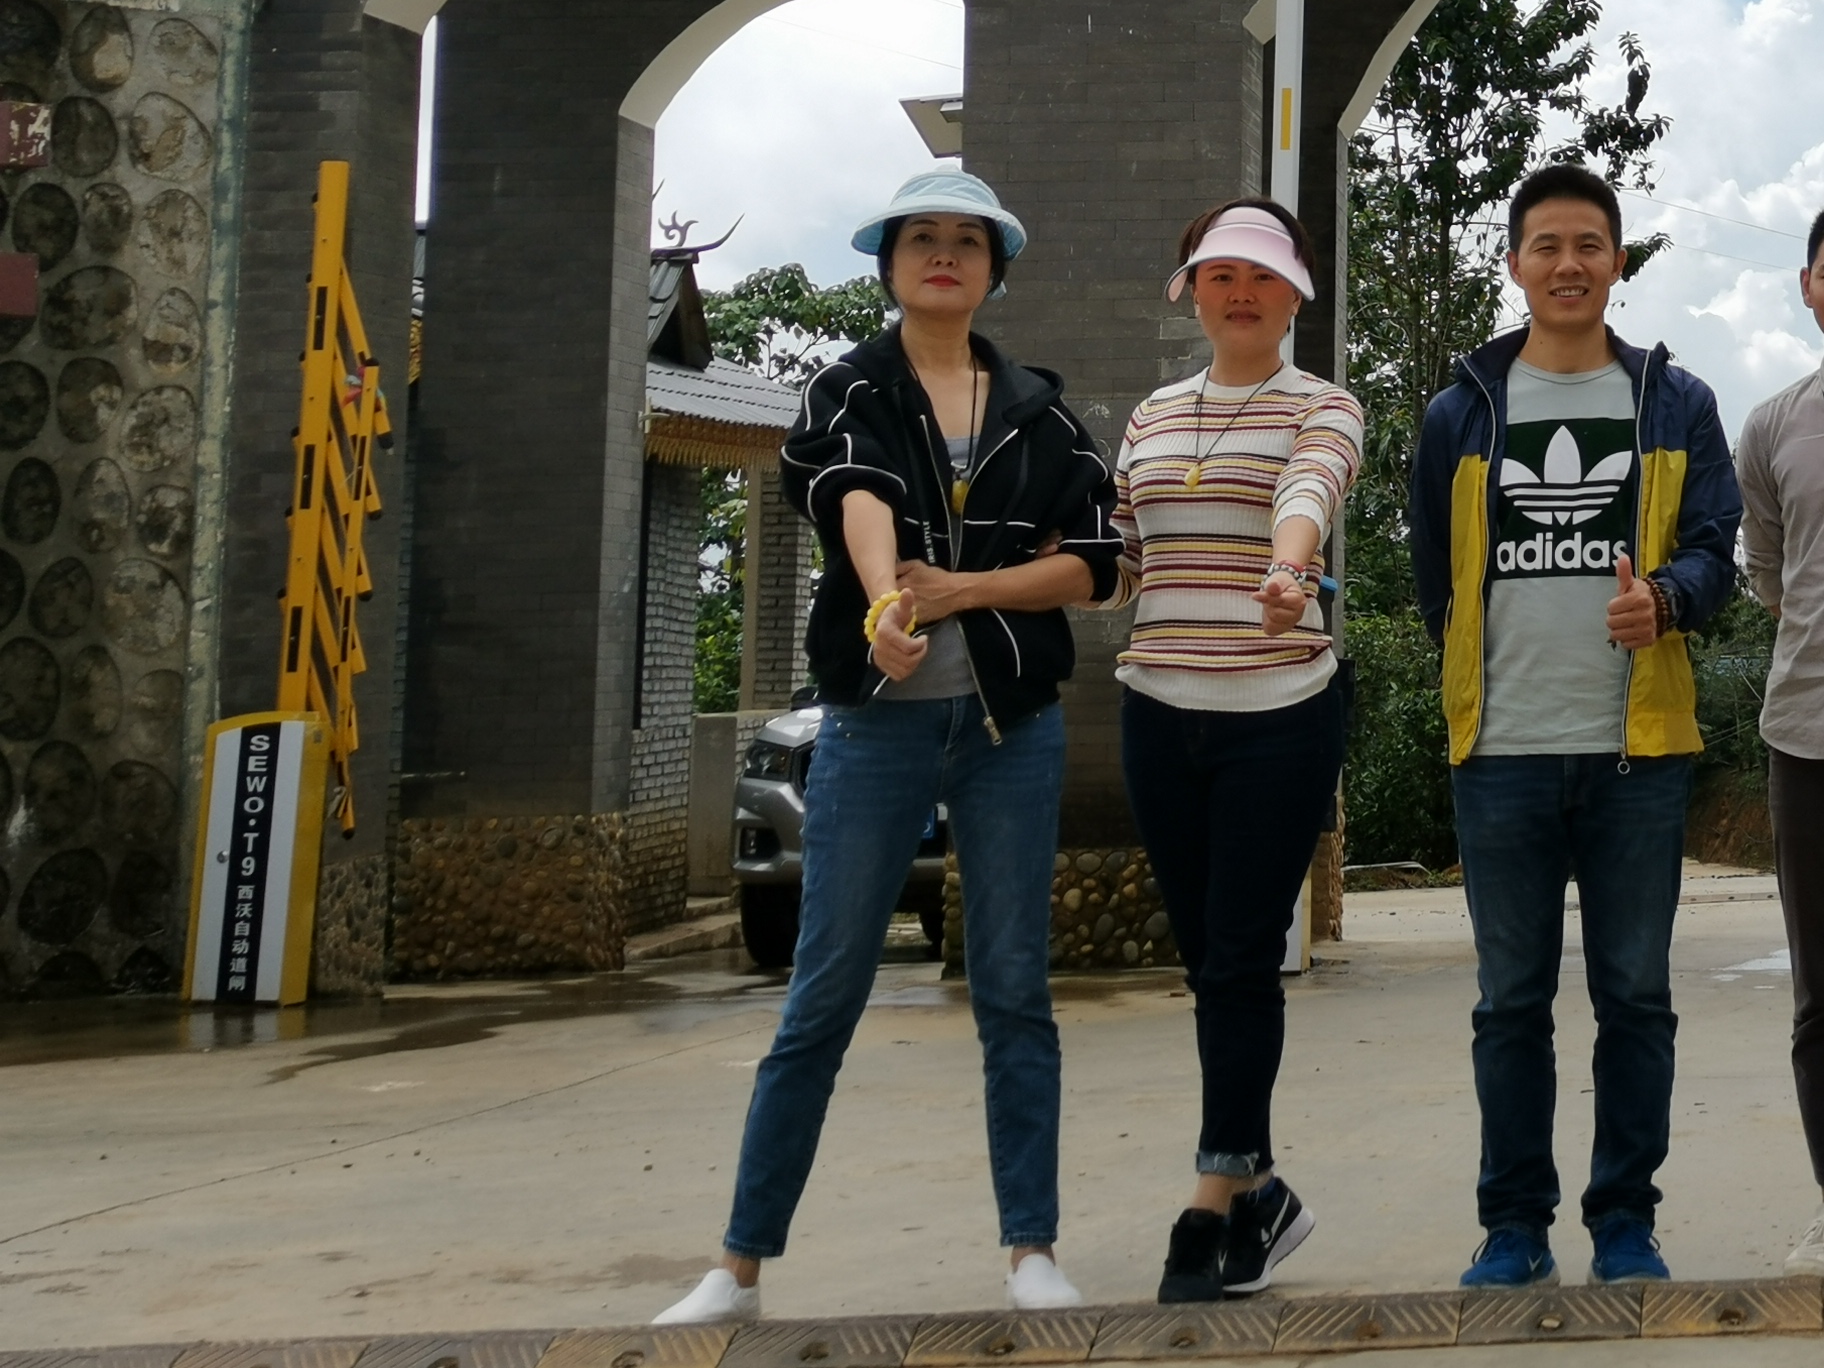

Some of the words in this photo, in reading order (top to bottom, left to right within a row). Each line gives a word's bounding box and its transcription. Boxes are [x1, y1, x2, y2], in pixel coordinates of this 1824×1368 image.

[1497, 532, 1629, 572] adidas
[227, 884, 256, 992] 西沃自动道闸
